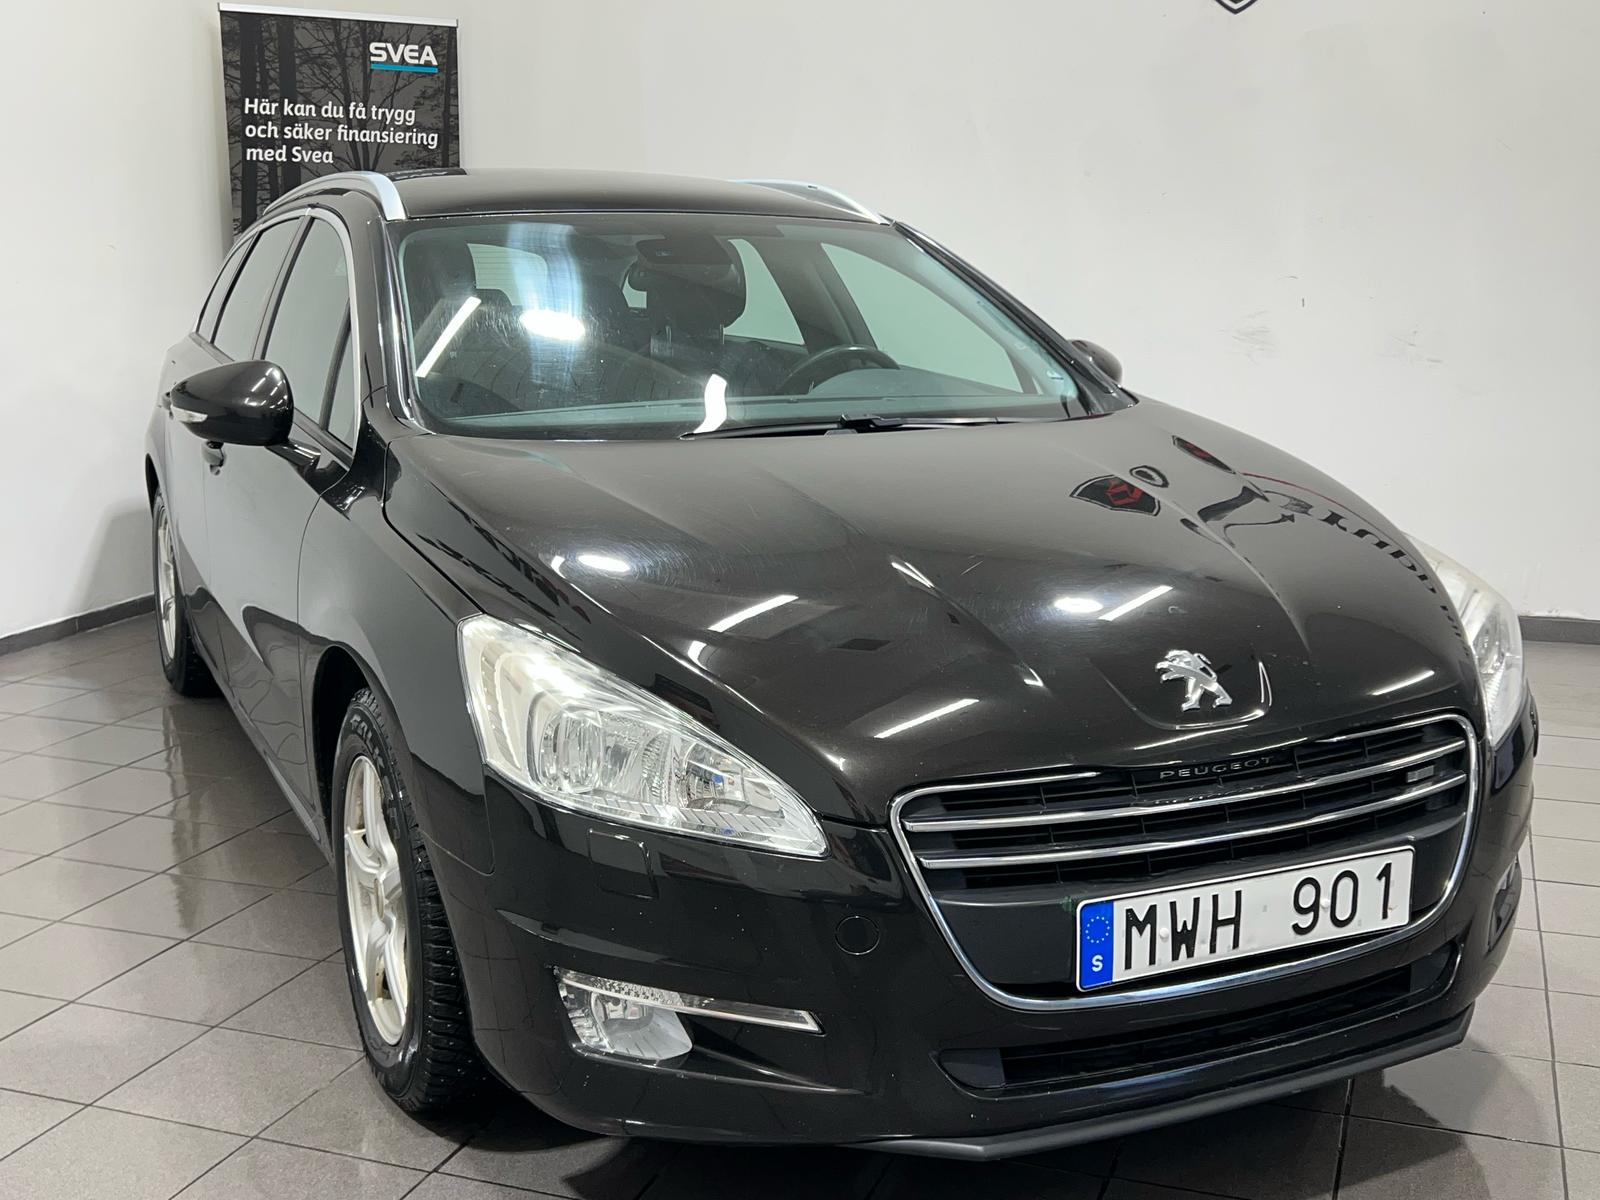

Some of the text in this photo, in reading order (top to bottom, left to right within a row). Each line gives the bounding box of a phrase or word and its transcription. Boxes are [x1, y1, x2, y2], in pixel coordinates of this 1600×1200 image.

[369, 42, 438, 65] SVEA
[244, 98, 416, 126] Här kan du få trygg
[245, 122, 438, 149] och säker finansiering
[246, 145, 334, 164] med Svea
[1160, 756, 1273, 779] PEUGEOT
[1124, 862, 1393, 970] MWH 901
[1091, 955, 1103, 973] S
